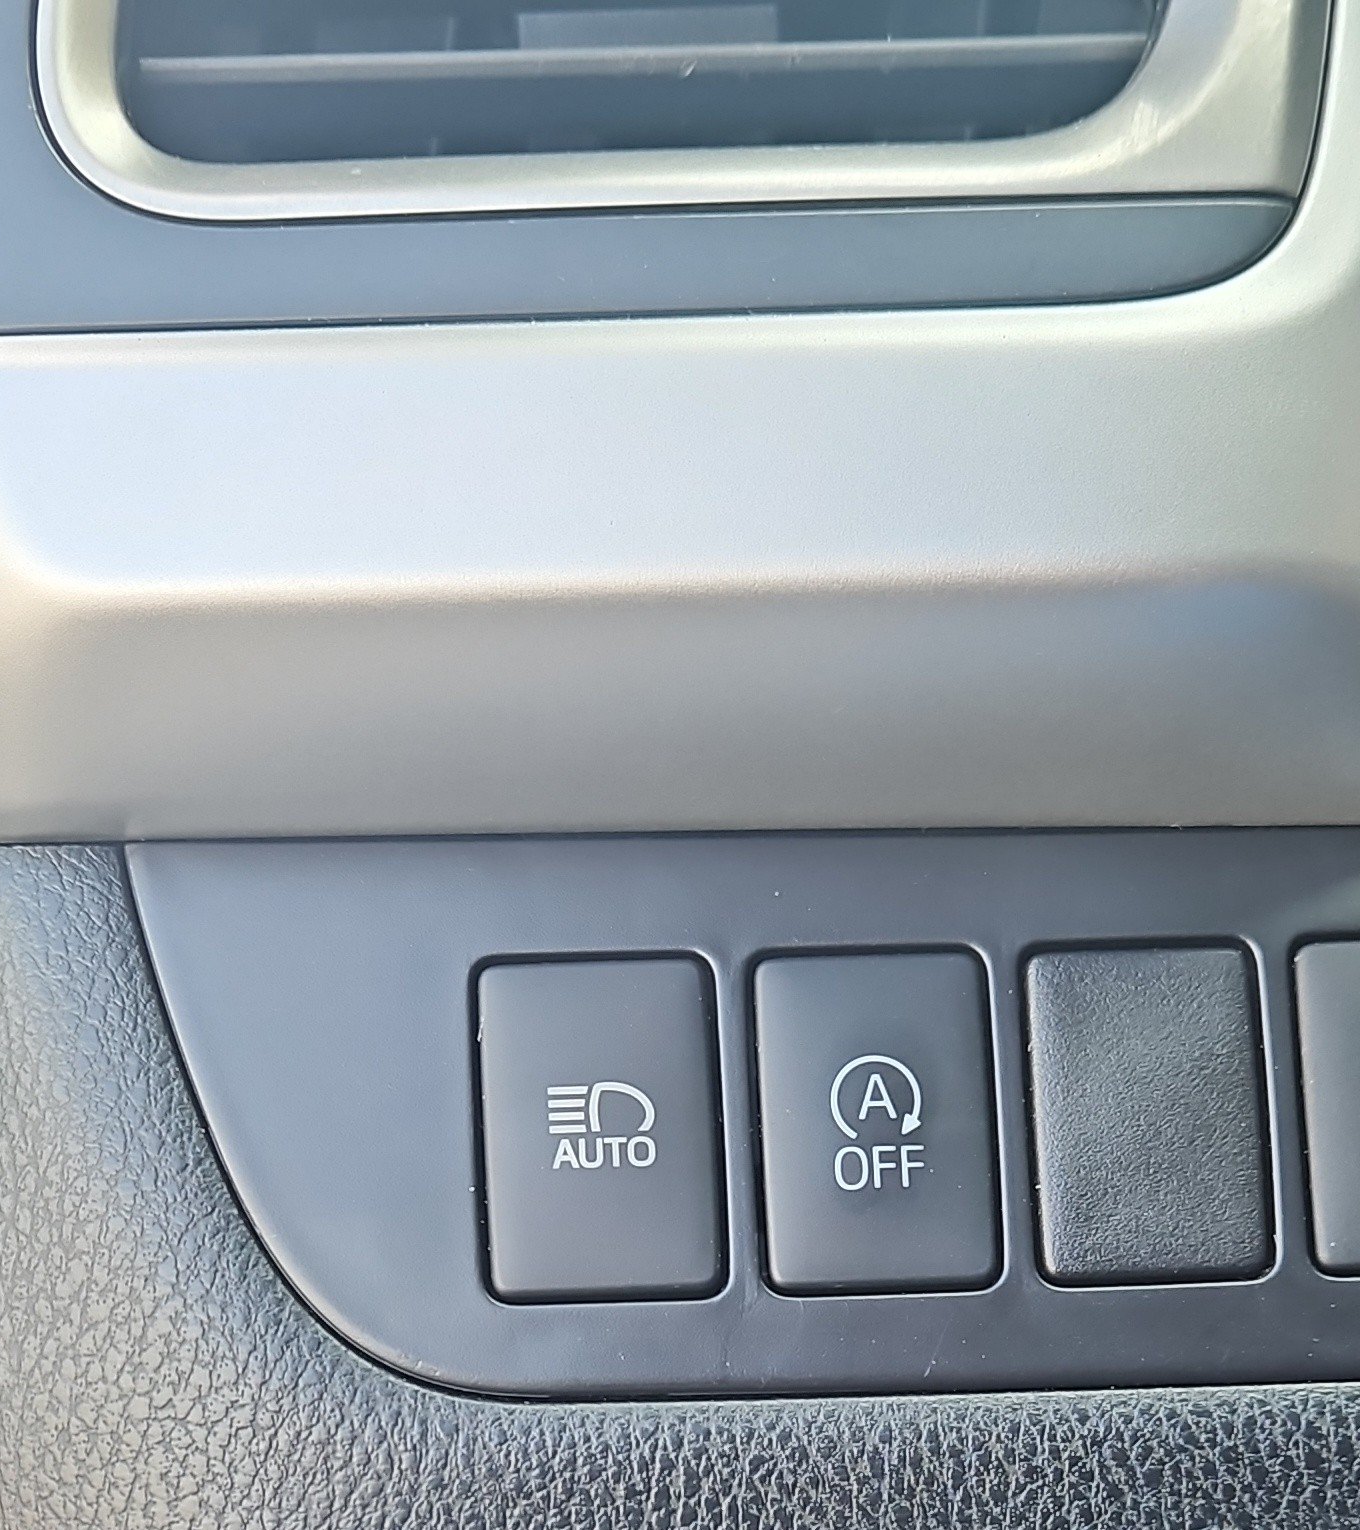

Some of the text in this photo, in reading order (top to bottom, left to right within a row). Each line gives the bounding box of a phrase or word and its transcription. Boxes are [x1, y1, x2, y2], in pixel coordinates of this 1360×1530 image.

[858, 1073, 898, 1120] A
[552, 1135, 657, 1170] AUTO
[834, 1144, 925, 1191] OFF
